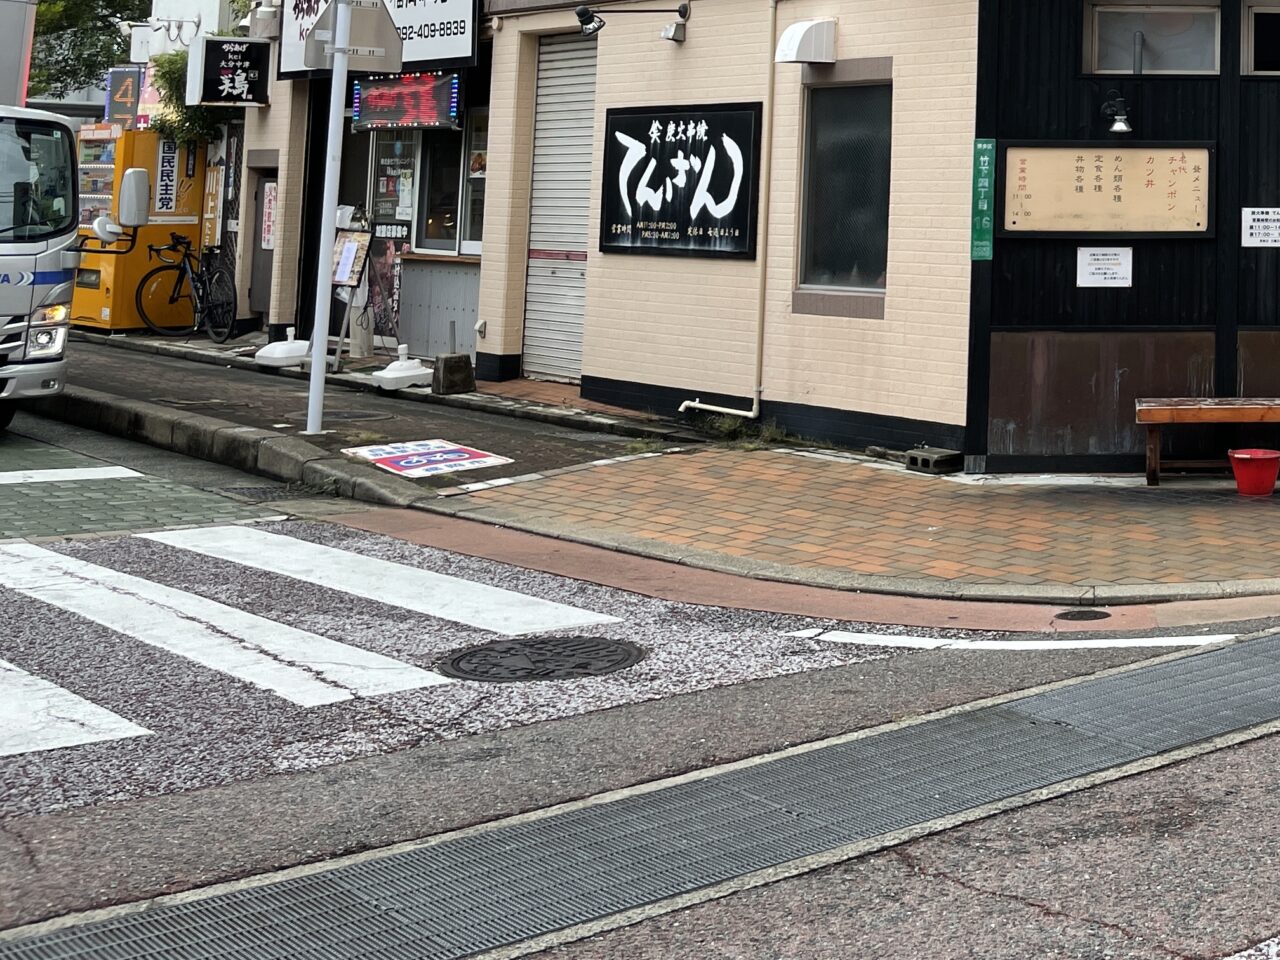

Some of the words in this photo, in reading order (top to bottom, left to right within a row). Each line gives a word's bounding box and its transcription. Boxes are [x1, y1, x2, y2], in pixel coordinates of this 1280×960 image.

[222, 43, 249, 52] からあげ
[114, 78, 134, 107] 4
[159, 141, 176, 210] 国民民主党
[615, 131, 743, 220] てんざん
[1018, 158, 1027, 191] 営業時間
[1074, 155, 1085, 193] 丼物各種
[1093, 155, 1104, 193] 定食各種
[1113, 155, 1123, 203] めん類各種
[1144, 156, 1155, 189] カツ丼
[1167, 156, 1178, 212] チャンポン
